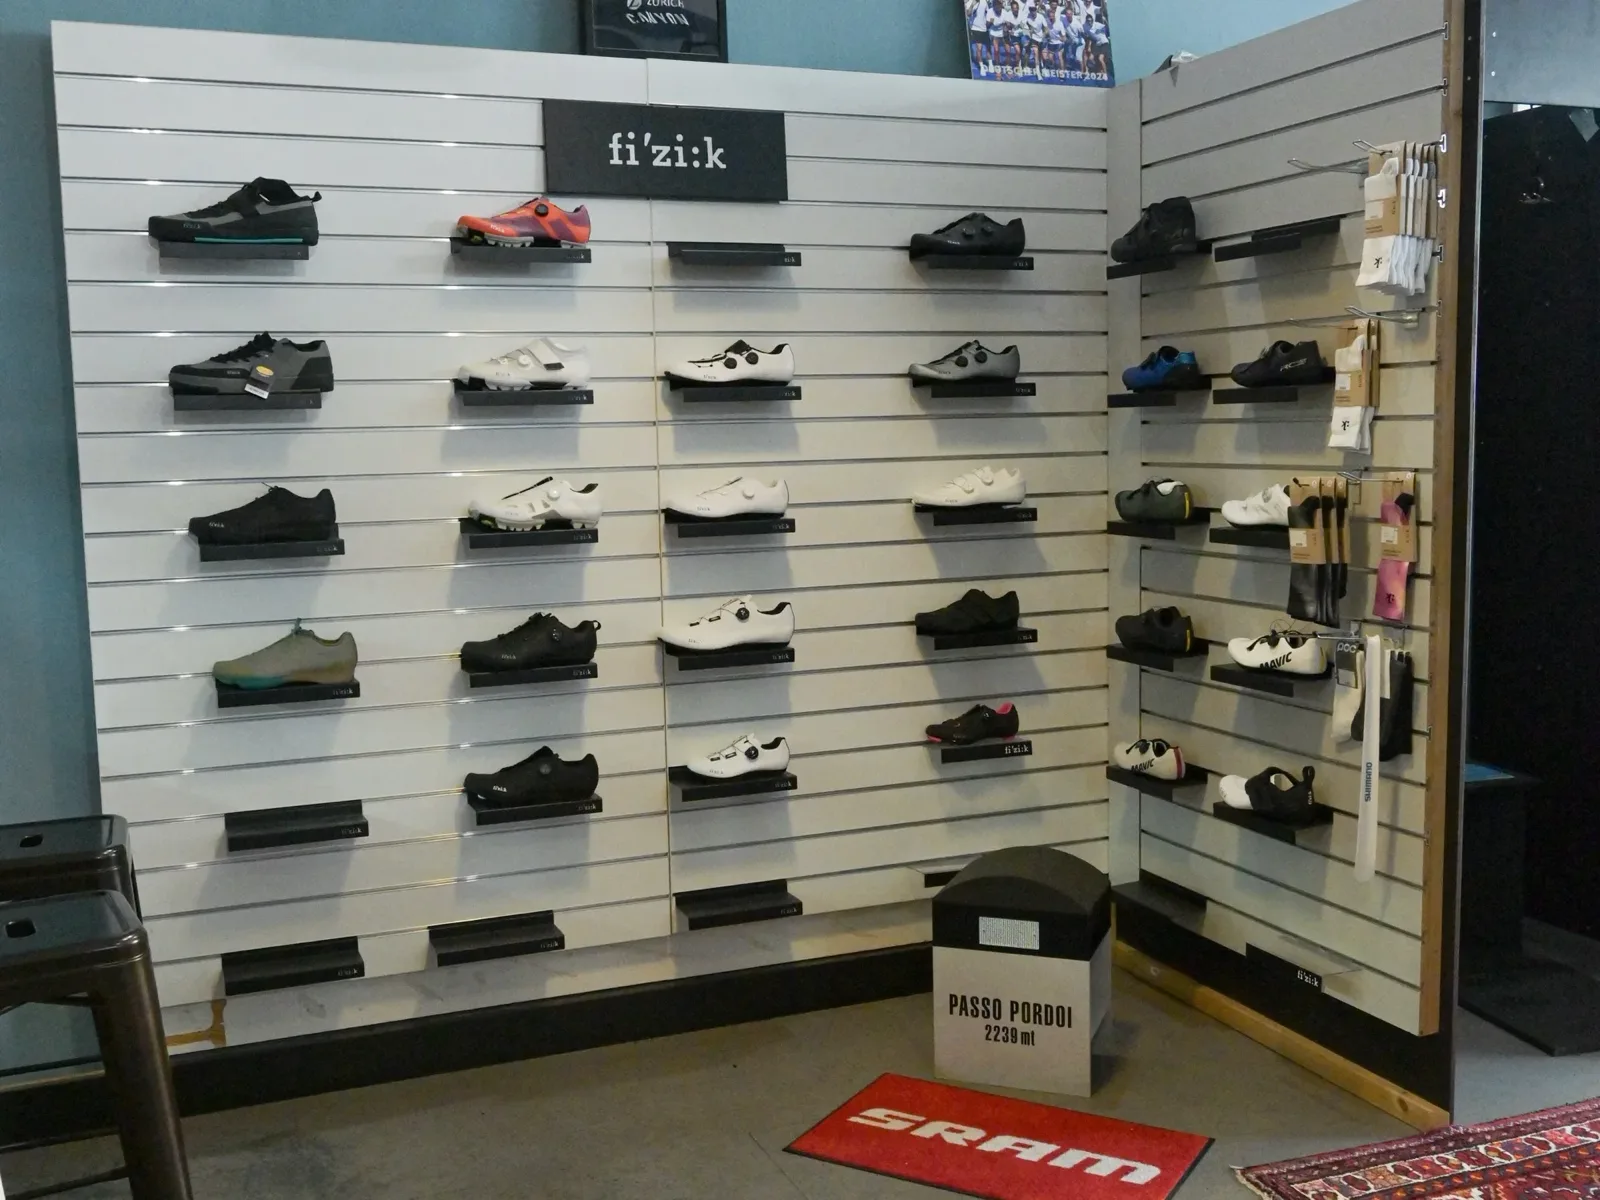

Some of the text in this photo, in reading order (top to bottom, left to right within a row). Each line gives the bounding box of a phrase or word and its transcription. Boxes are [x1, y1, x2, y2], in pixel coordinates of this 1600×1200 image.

[609, 131, 727, 169] fi'zi:k
[949, 993, 1072, 1029] PASSO PORDOI
[846, 1107, 1162, 1185] SRAM
